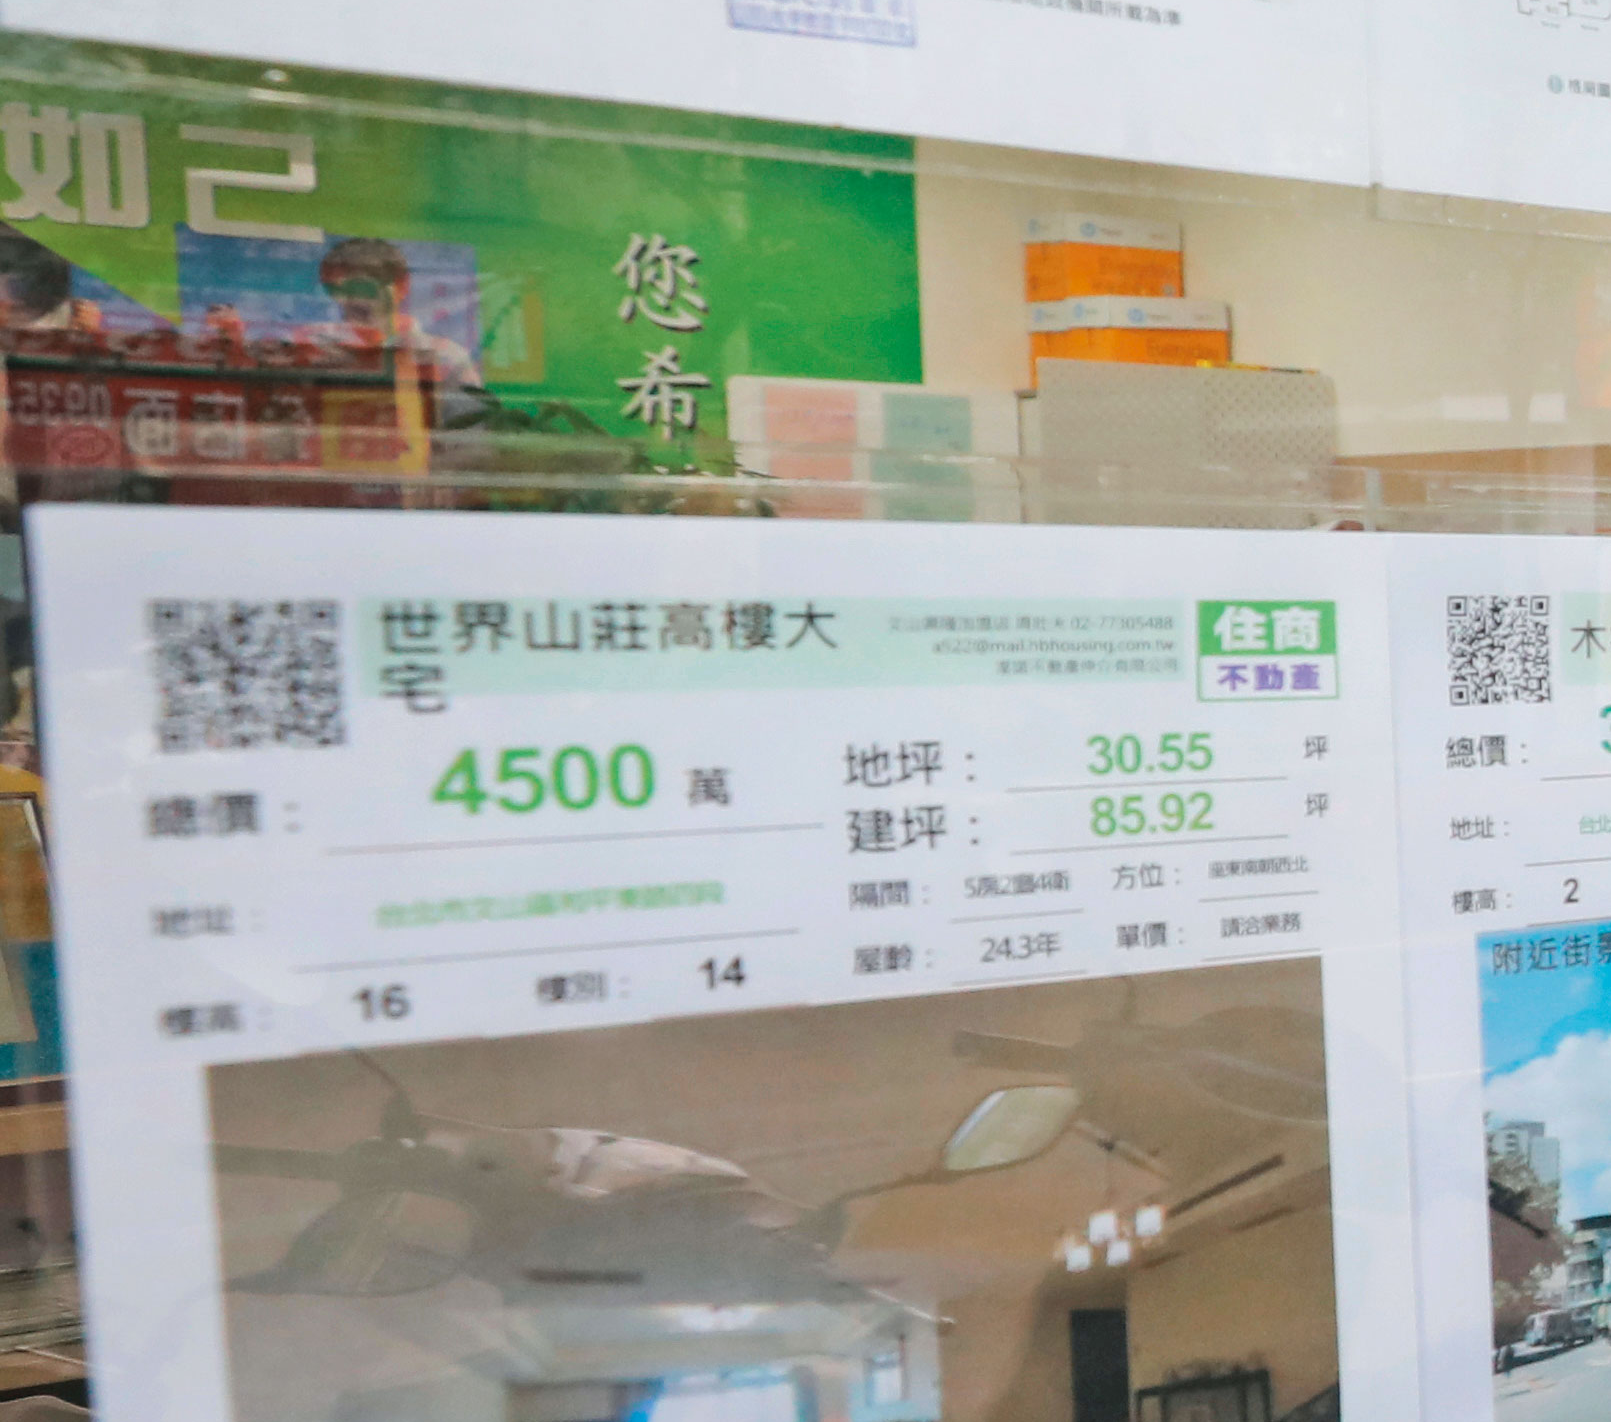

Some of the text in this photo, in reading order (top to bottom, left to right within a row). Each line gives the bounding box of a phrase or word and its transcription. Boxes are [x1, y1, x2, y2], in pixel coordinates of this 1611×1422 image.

[615, 232, 709, 443] 您希
[379, 598, 838, 657] 世界山莊高樓大
[1213, 605, 1324, 651] 住商
[379, 660, 448, 715] 宅
[1216, 664, 1322, 693] 不動產
[432, 742, 731, 815] 4500 萬
[1087, 732, 1214, 776] 30.55
[1304, 734, 1329, 760] 坪
[1089, 791, 1216, 837] 85.92
[1305, 793, 1329, 818] 坪
[1563, 878, 1579, 904] 2
[354, 957, 746, 1019] 16 14
